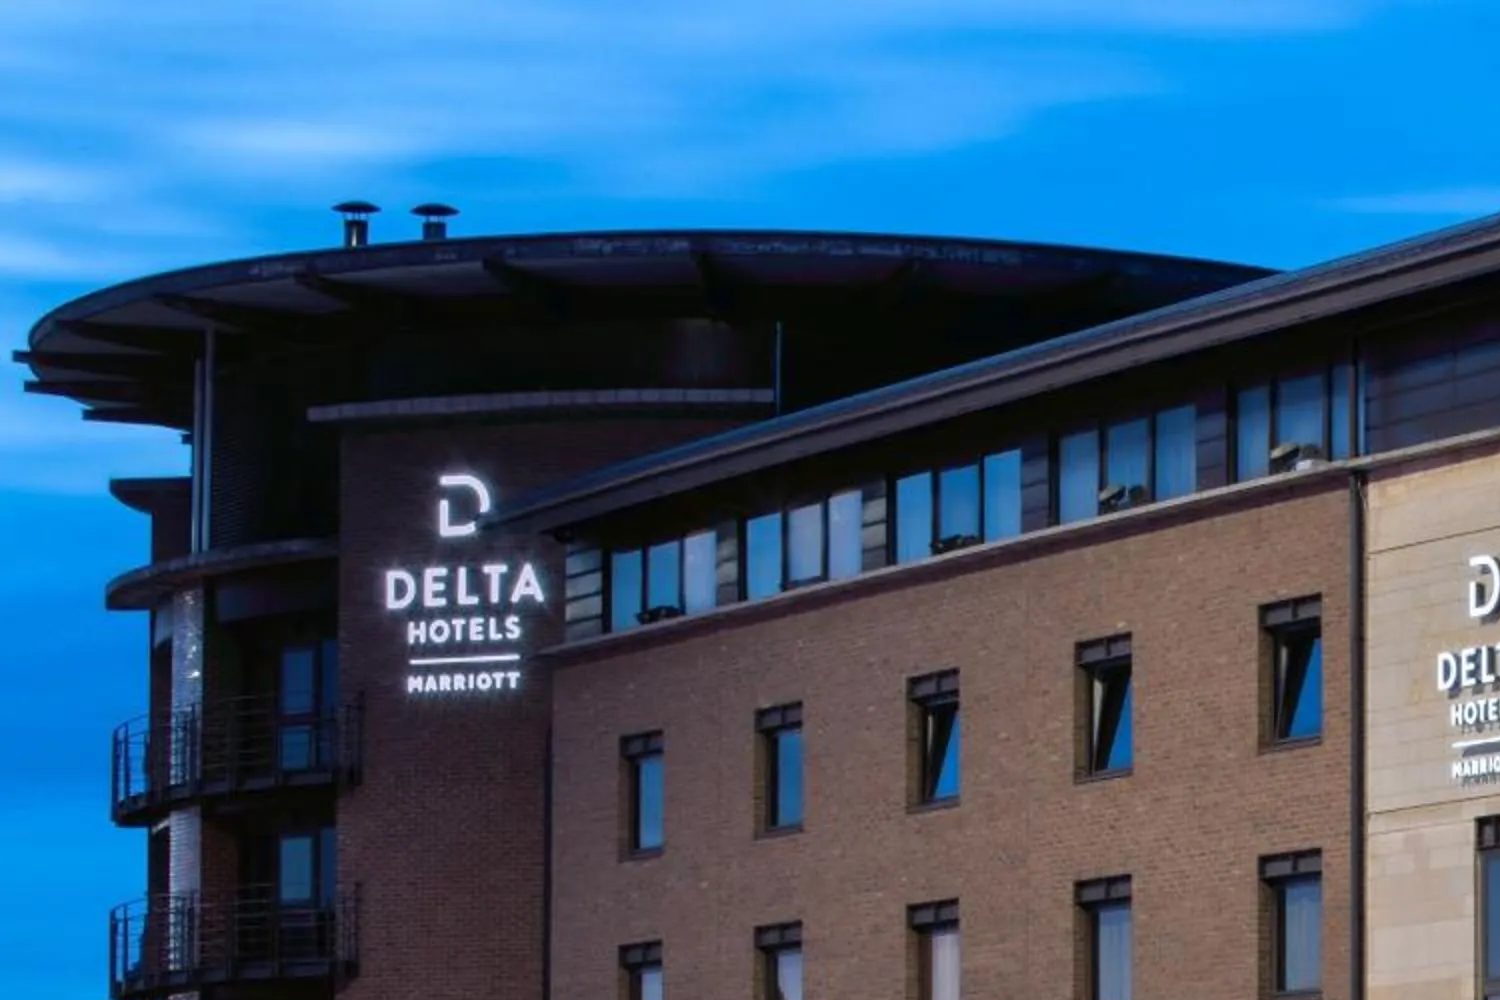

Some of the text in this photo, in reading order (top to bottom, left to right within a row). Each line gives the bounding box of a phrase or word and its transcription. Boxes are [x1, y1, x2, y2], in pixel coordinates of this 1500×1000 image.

[384, 563, 545, 611] DELTA
[407, 615, 521, 645] HOTELS
[407, 671, 521, 694] MARRIOTT
